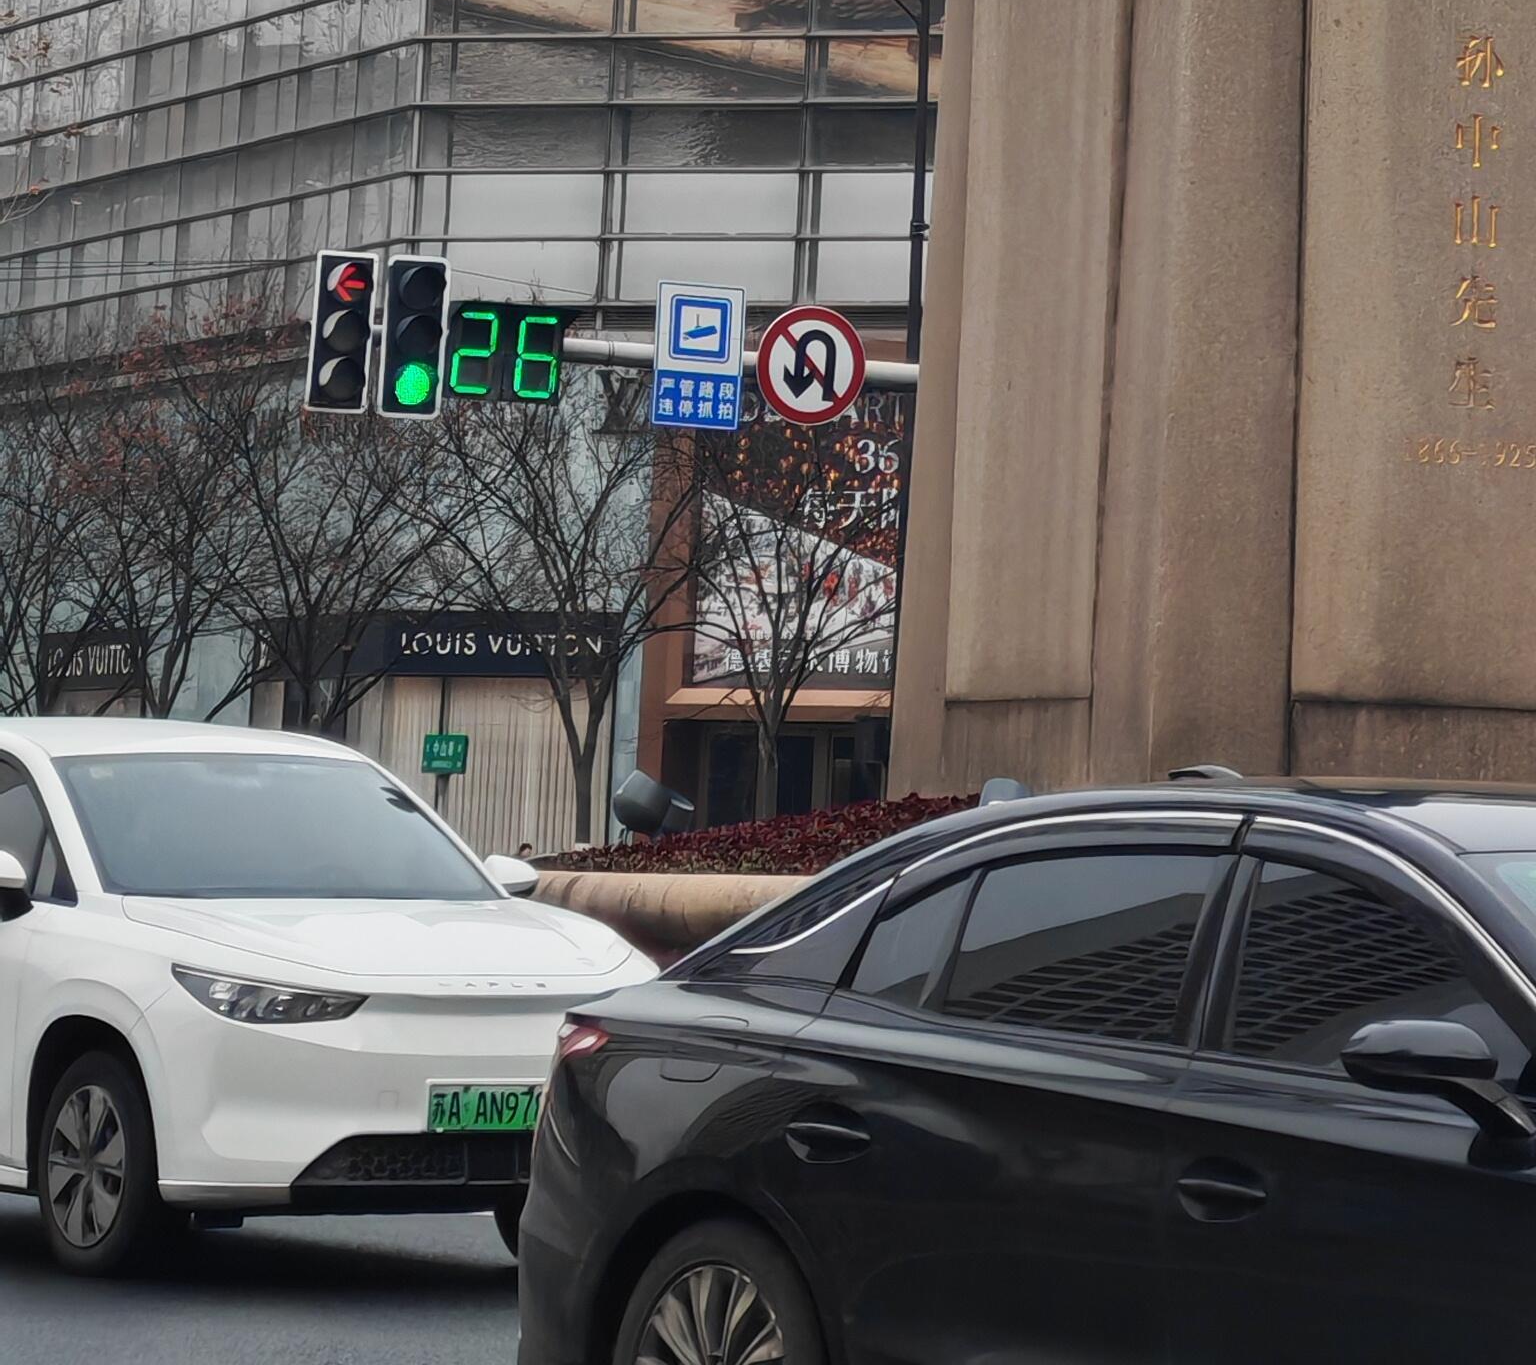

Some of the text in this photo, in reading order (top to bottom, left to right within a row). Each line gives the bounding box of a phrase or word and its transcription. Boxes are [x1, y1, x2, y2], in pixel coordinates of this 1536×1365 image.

[1447, 33, 1505, 412] 孙中山先生
[450, 310, 558, 400] 26
[658, 377, 736, 401] 严管路段
[657, 398, 735, 420] 违停抓拍
[401, 632, 477, 656] LOUIS
